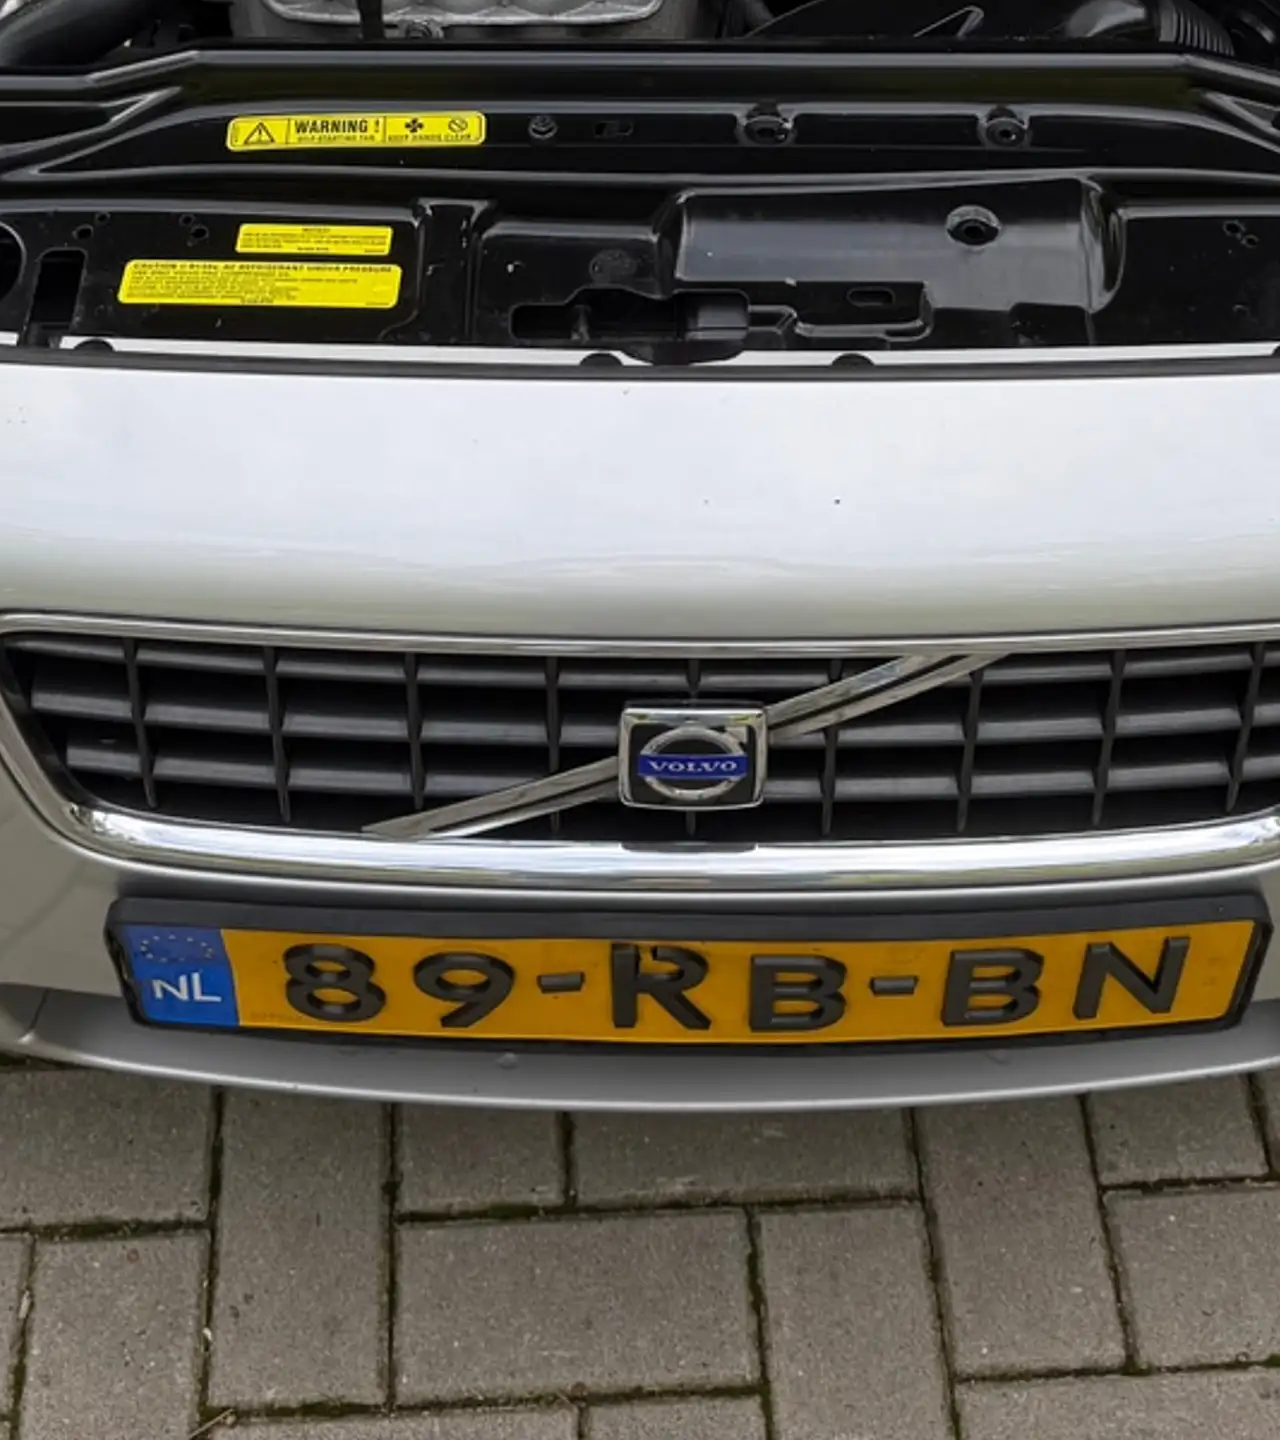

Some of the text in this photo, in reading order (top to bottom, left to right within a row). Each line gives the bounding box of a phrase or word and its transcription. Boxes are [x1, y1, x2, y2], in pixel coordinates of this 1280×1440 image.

[295, 119, 381, 134] WARNING !
[648, 760, 738, 773] VOLVO
[152, 971, 222, 1003] NL
[282, 936, 1190, 1033] 89-RB-BN
